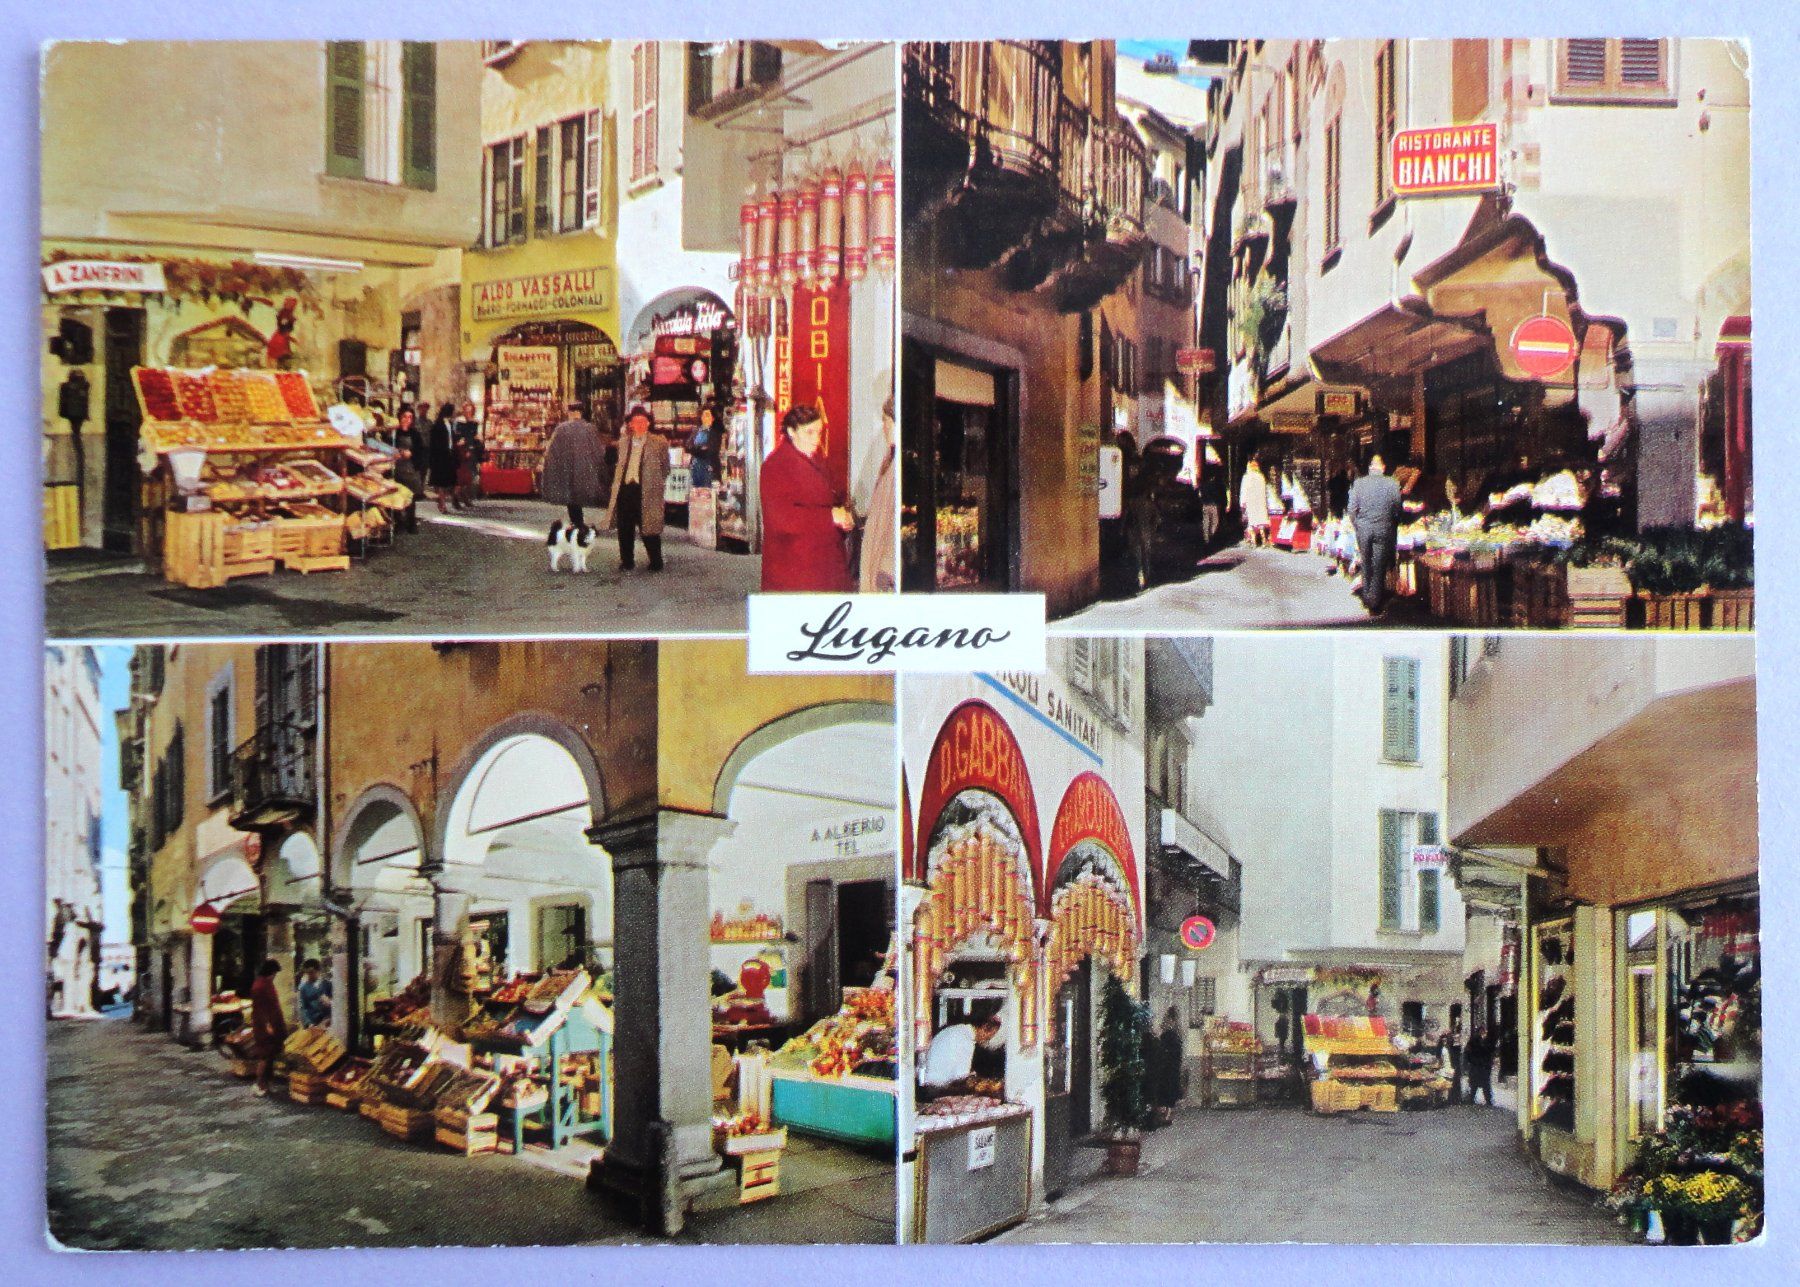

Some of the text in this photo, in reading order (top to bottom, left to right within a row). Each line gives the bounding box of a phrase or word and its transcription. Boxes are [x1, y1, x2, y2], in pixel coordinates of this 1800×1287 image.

[1399, 130, 1491, 151] RISTORANTE
[1399, 152, 1491, 186] BIANCHI
[481, 269, 596, 301] ALDO VASSALLI
[552, 292, 603, 309] COLONIALI
[778, 337, 790, 412] UMER
[786, 600, 1011, 664] Lugano
[1047, 687, 1100, 754] SANITARI
